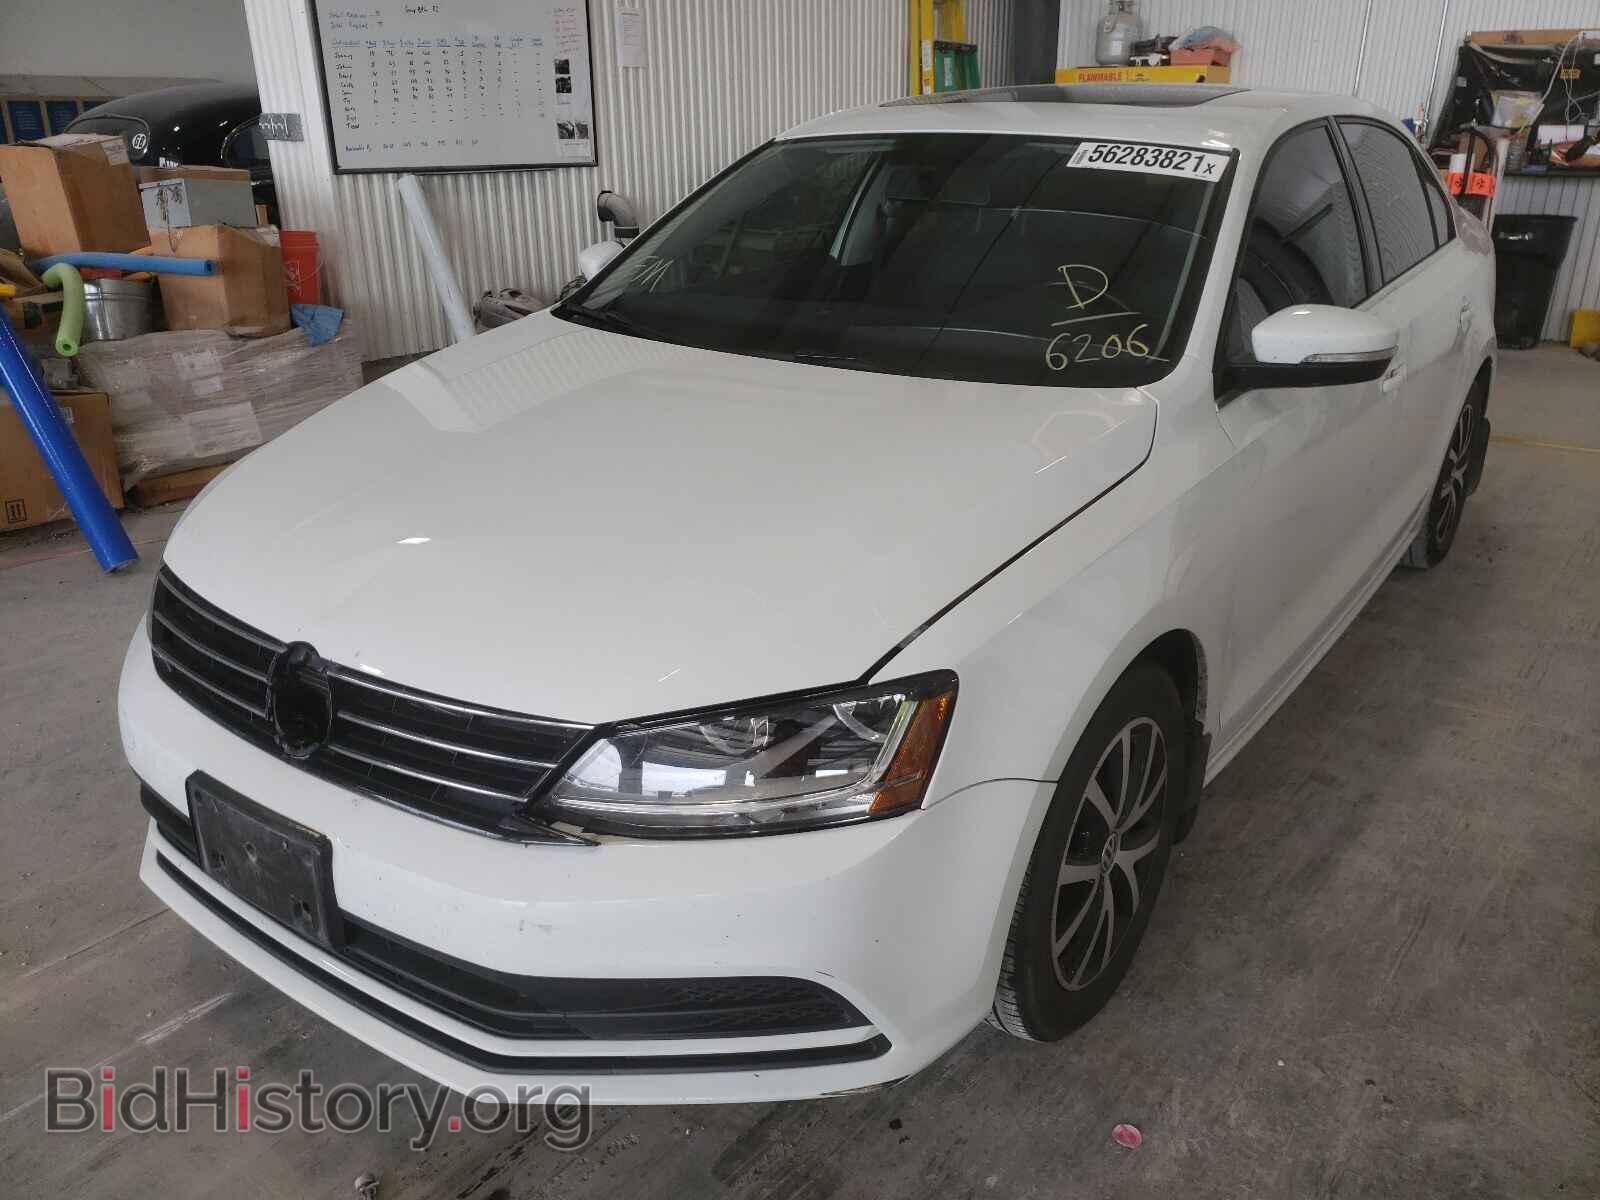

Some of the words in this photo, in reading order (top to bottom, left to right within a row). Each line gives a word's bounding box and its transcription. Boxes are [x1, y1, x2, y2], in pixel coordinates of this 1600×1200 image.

[1088, 144, 1206, 173] 56283821
[1057, 264, 1109, 310] D
[1045, 323, 1150, 370] 6206
